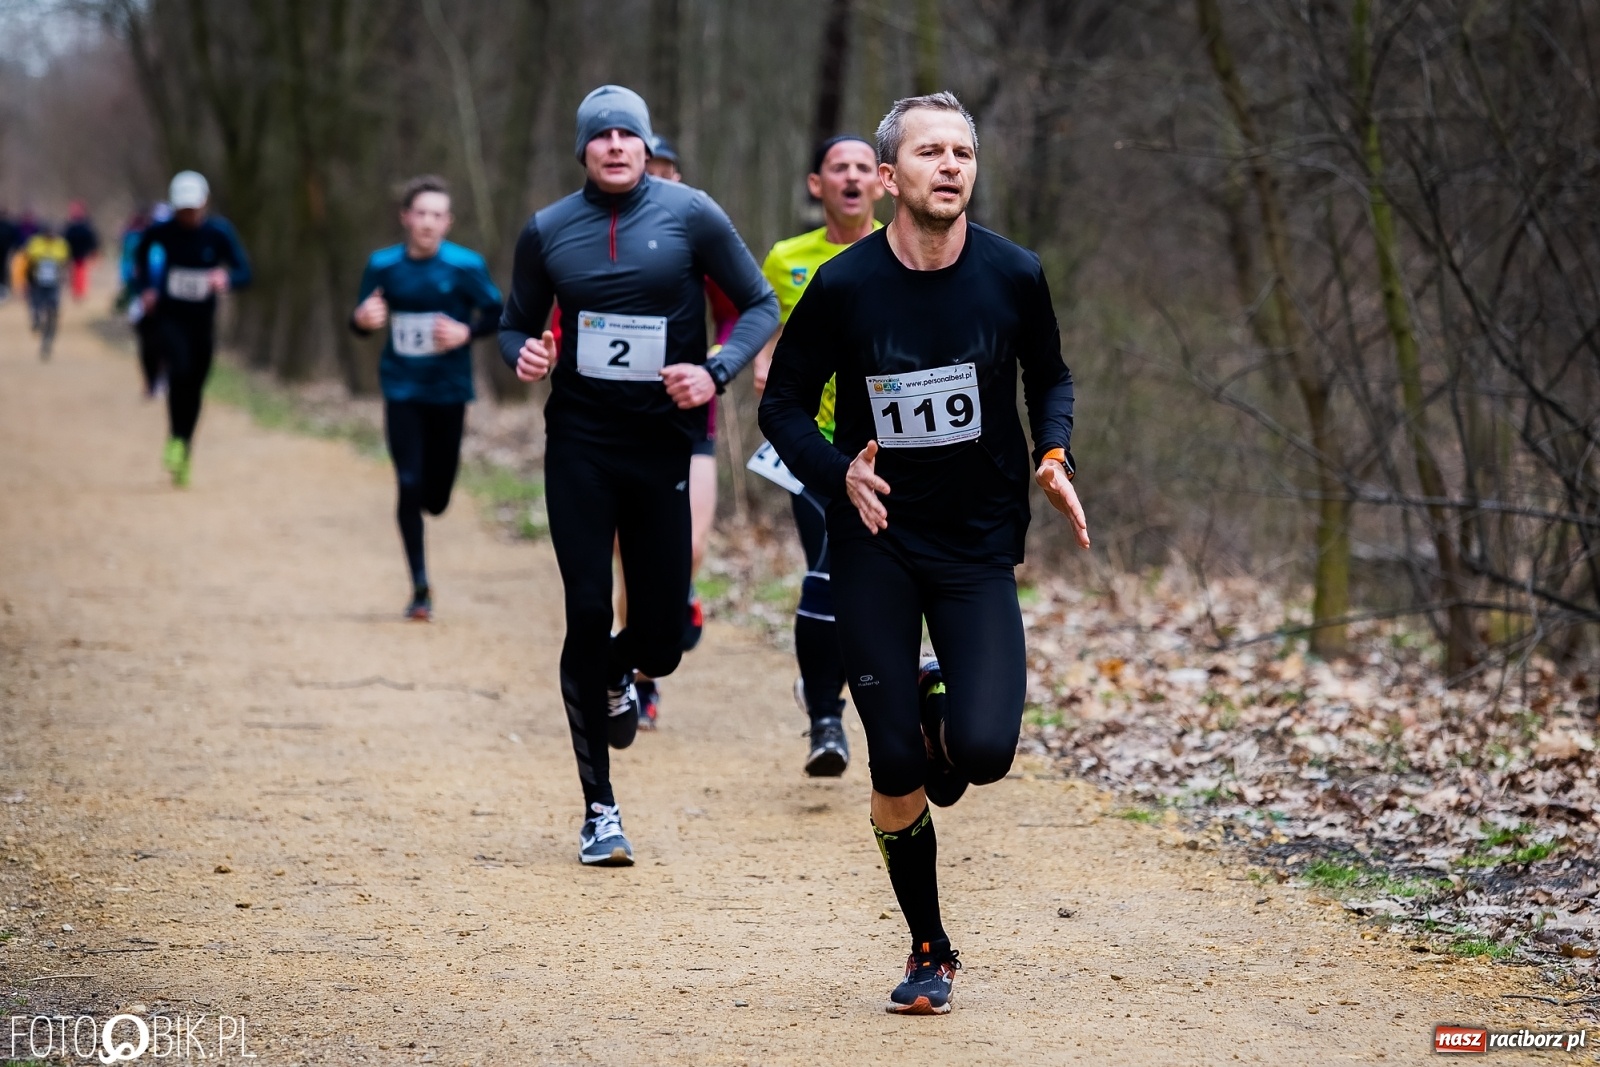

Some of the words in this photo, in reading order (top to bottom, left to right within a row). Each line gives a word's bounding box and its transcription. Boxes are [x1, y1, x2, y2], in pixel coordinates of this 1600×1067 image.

[607, 338, 630, 368] 2
[905, 371, 973, 388] www.personalbest.pl
[881, 393, 974, 434] 119
